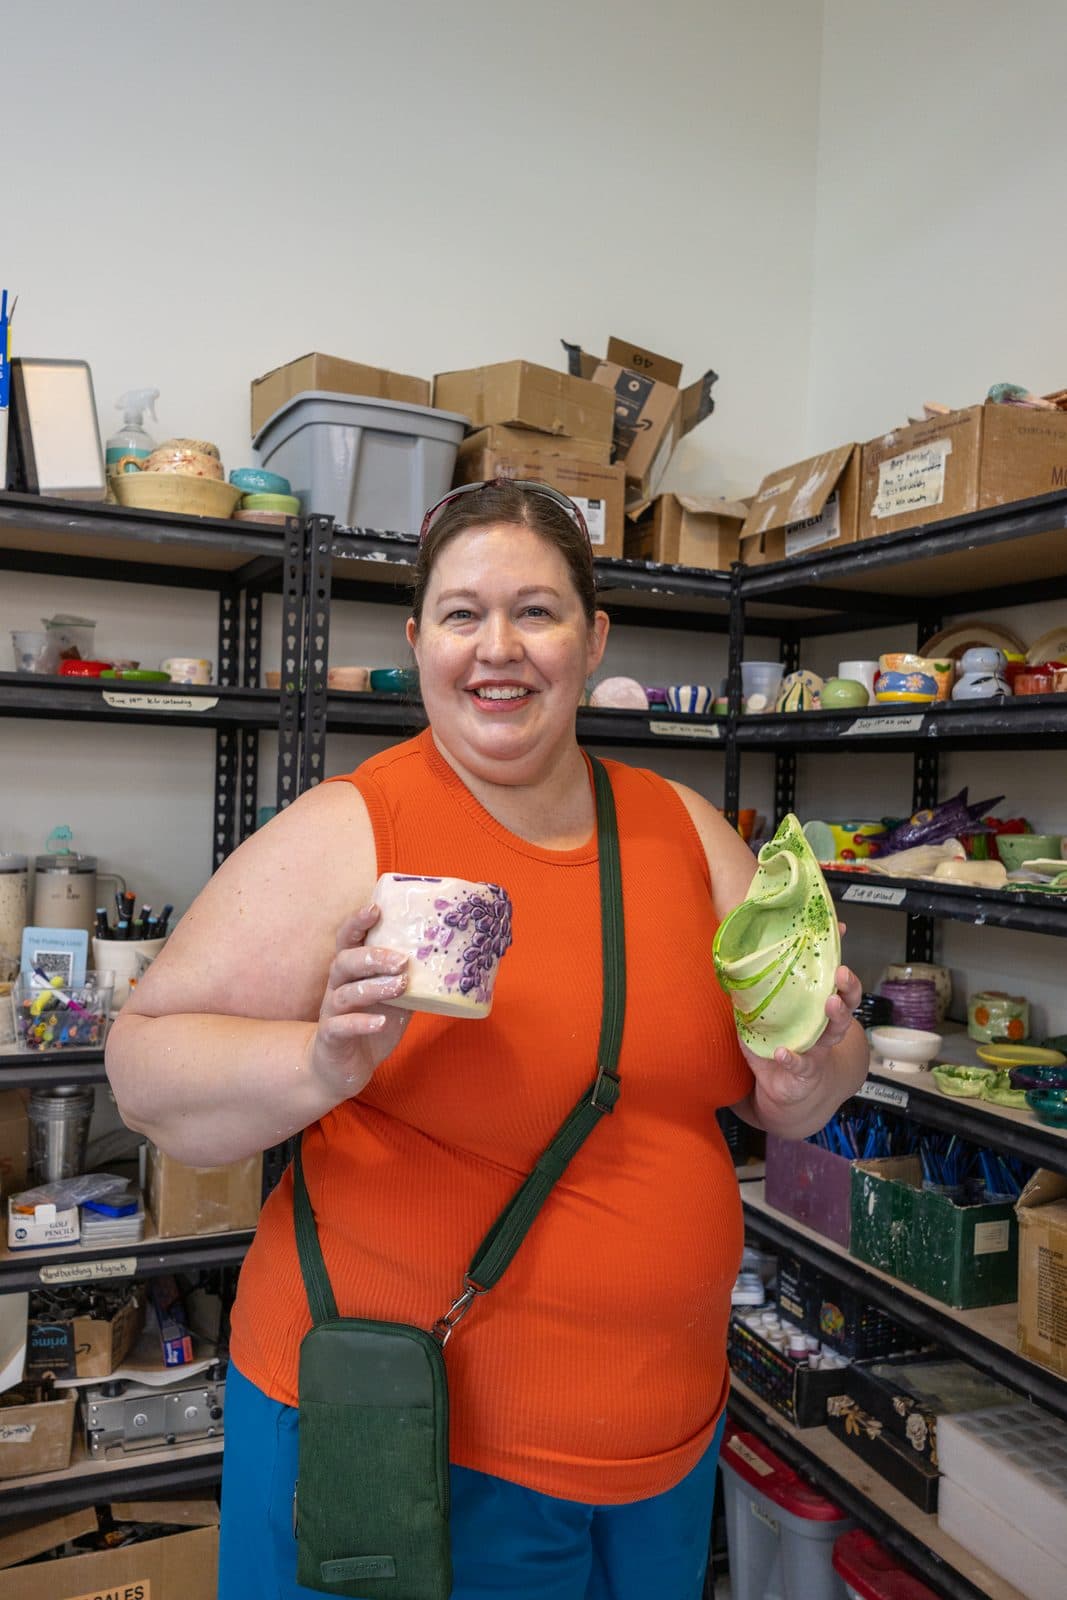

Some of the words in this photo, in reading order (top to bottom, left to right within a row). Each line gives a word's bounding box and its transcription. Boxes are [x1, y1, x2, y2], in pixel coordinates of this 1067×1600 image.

[807, 514, 822, 527] CLAY
[49, 1220, 68, 1230] GOLF
[44, 1226, 75, 1238] PENCILS
[32, 1335, 68, 1348] prime
[94, 1585, 144, 1600] LES
